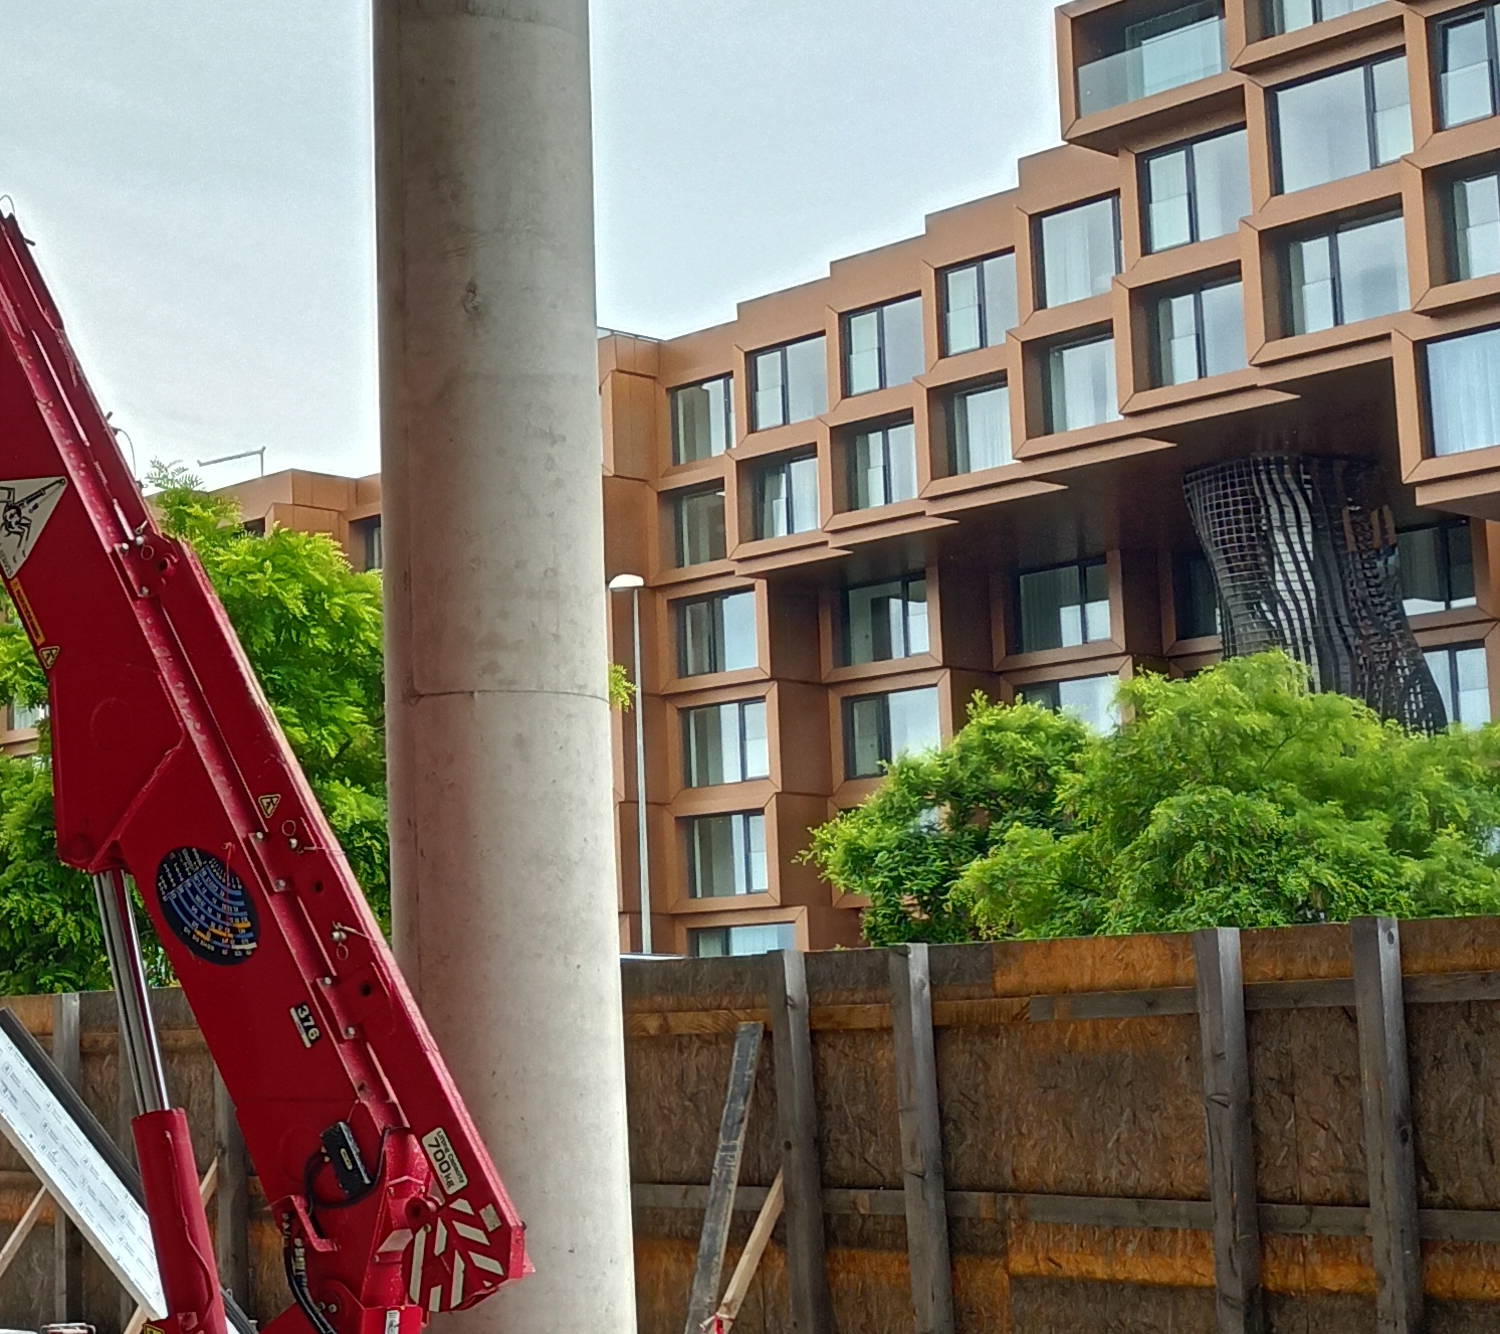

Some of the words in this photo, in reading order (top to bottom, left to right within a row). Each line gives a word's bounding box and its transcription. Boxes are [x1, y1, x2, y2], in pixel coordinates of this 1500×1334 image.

[297, 1004, 320, 1040] 376
[436, 1130, 451, 1153] Lifting
[446, 1153, 466, 1184] Capacity
